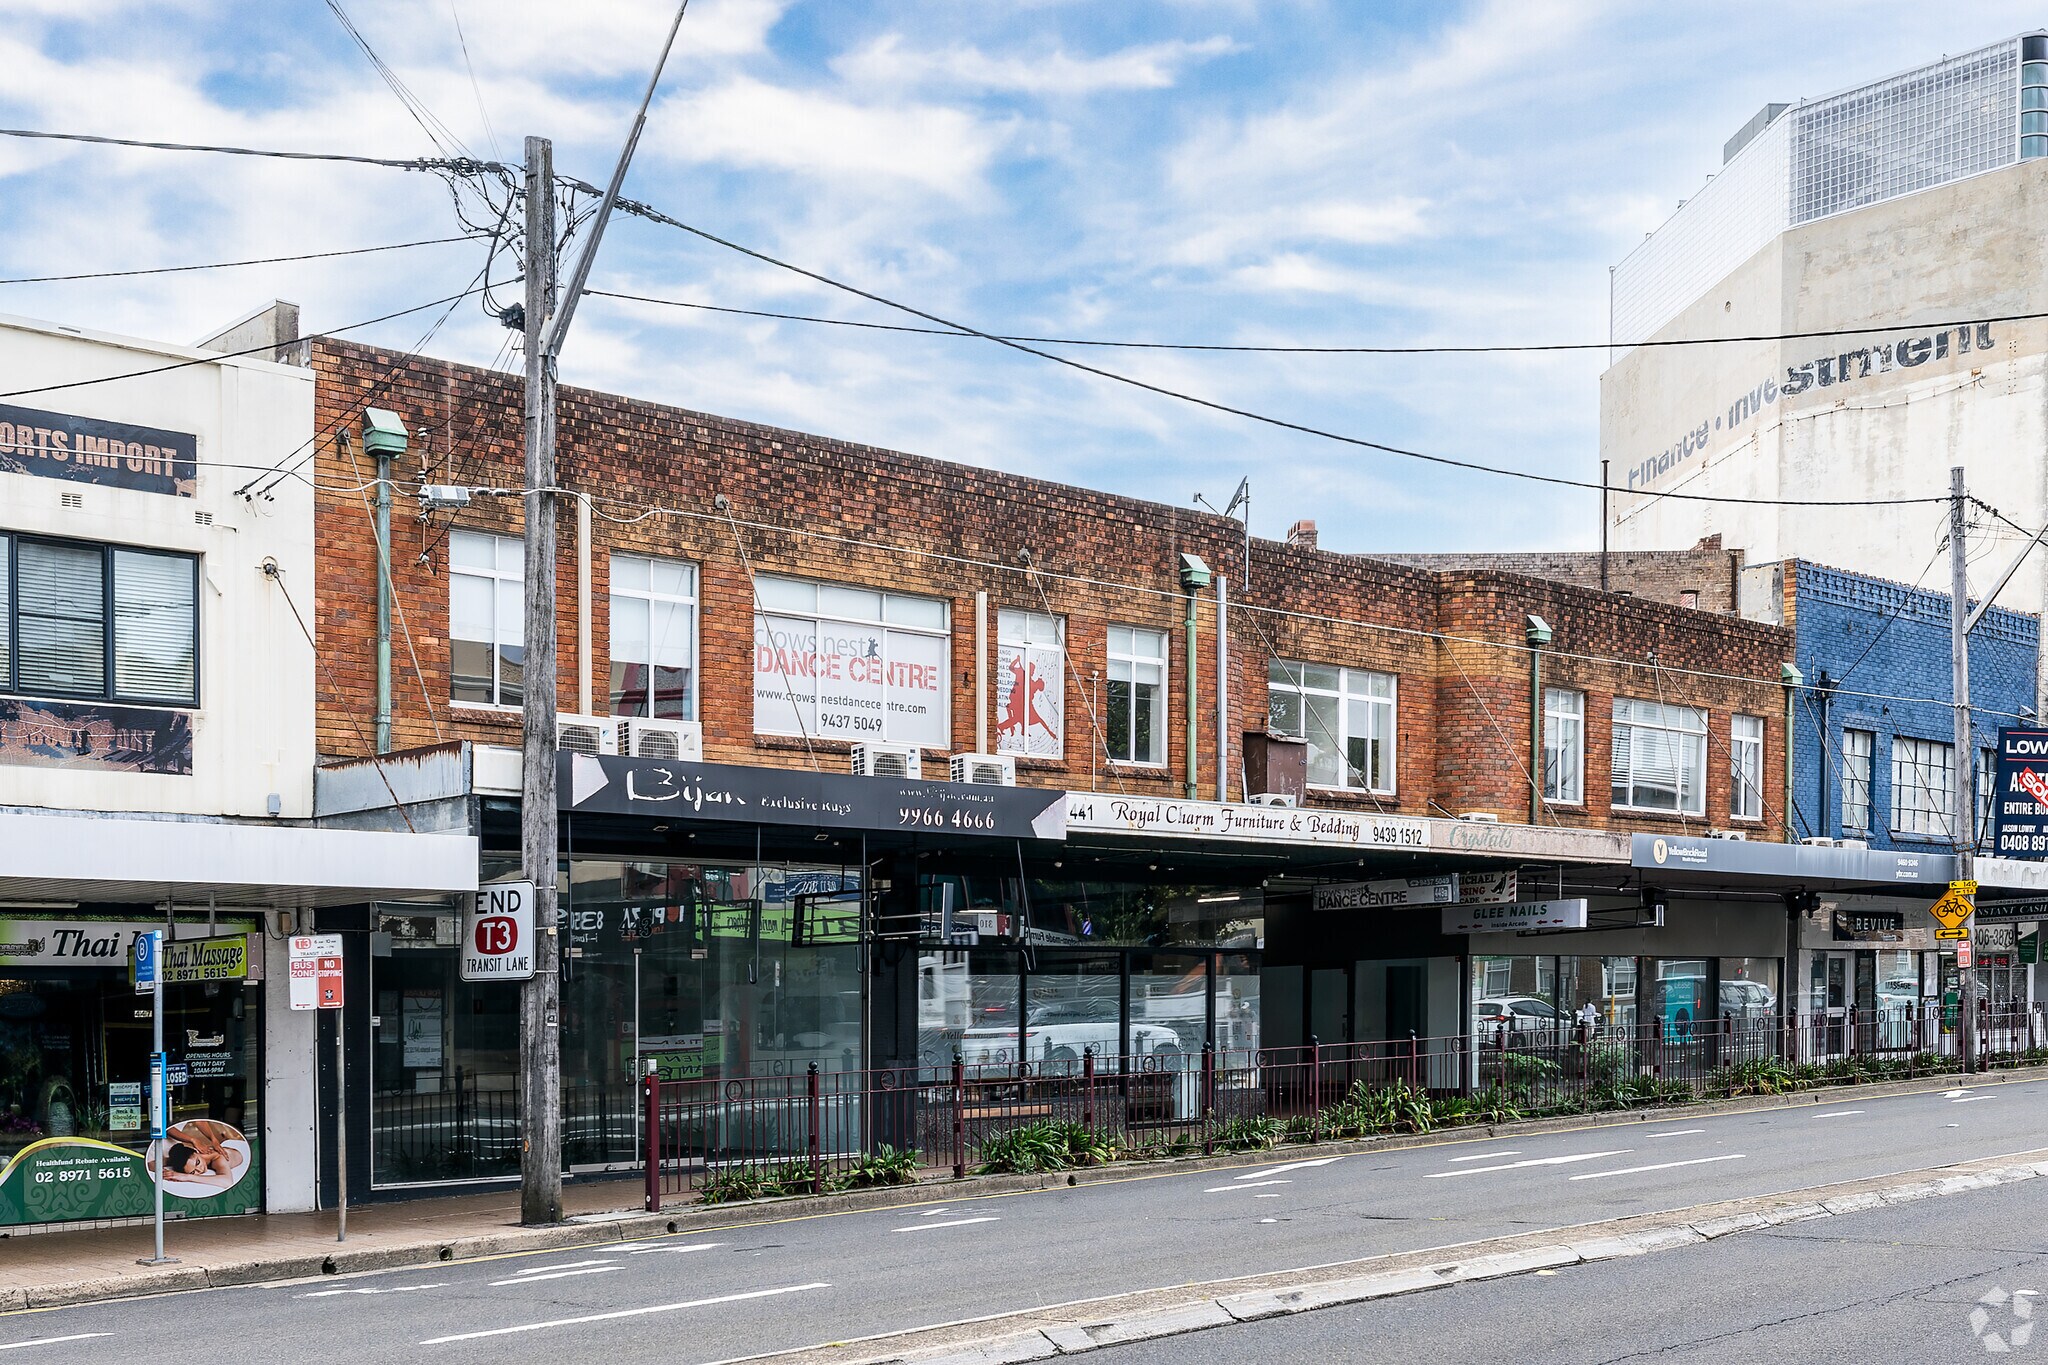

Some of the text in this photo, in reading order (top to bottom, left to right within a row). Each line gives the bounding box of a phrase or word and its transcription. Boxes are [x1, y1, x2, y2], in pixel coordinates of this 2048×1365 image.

[1728, 322, 1996, 431] investment
[75, 433, 177, 477] IMPORT
[754, 628, 866, 658] crows nest
[757, 645, 937, 691] DANCE CENTRE
[821, 713, 882, 732] 9437 5049
[626, 768, 852, 815] Bijan Exclusive Rugs
[2004, 801, 2033, 814] ENTIRE
[899, 807, 995, 830] 9966 4666
[1069, 803, 1093, 821] 441
[1111, 801, 1160, 829] Royal
[1220, 808, 1285, 833] Furniture
[1289, 815, 1301, 832] &
[1307, 816, 1360, 842] Bedding
[1373, 826, 1422, 845] 9439 1512
[2002, 824, 2018, 833] JASON
[2018, 825, 2036, 833] LOWRY
[2001, 834, 2029, 851] 0408
[475, 890, 521, 914] END
[1318, 890, 1408, 909] DANCE CENTRE
[1473, 904, 1547, 919] GLEE NAILS
[1977, 904, 2047, 916] NSTANT CASH
[1855, 917, 1895, 931] REVIVE
[52, 930, 121, 958] Thai
[296, 939, 310, 949] T3
[482, 921, 511, 950] T3
[162, 943, 243, 970] Thai Massage
[324, 960, 335, 968] NO
[467, 957, 529, 973] TRANSIT LANE
[176, 969, 199, 980] 8971
[204, 967, 228, 979] 5615
[166, 1071, 187, 1083] LOSED
[36, 1158, 73, 1167] Healthfund
[75, 1157, 98, 1165] Rebate
[35, 1167, 131, 1183] 02 8971 5615
